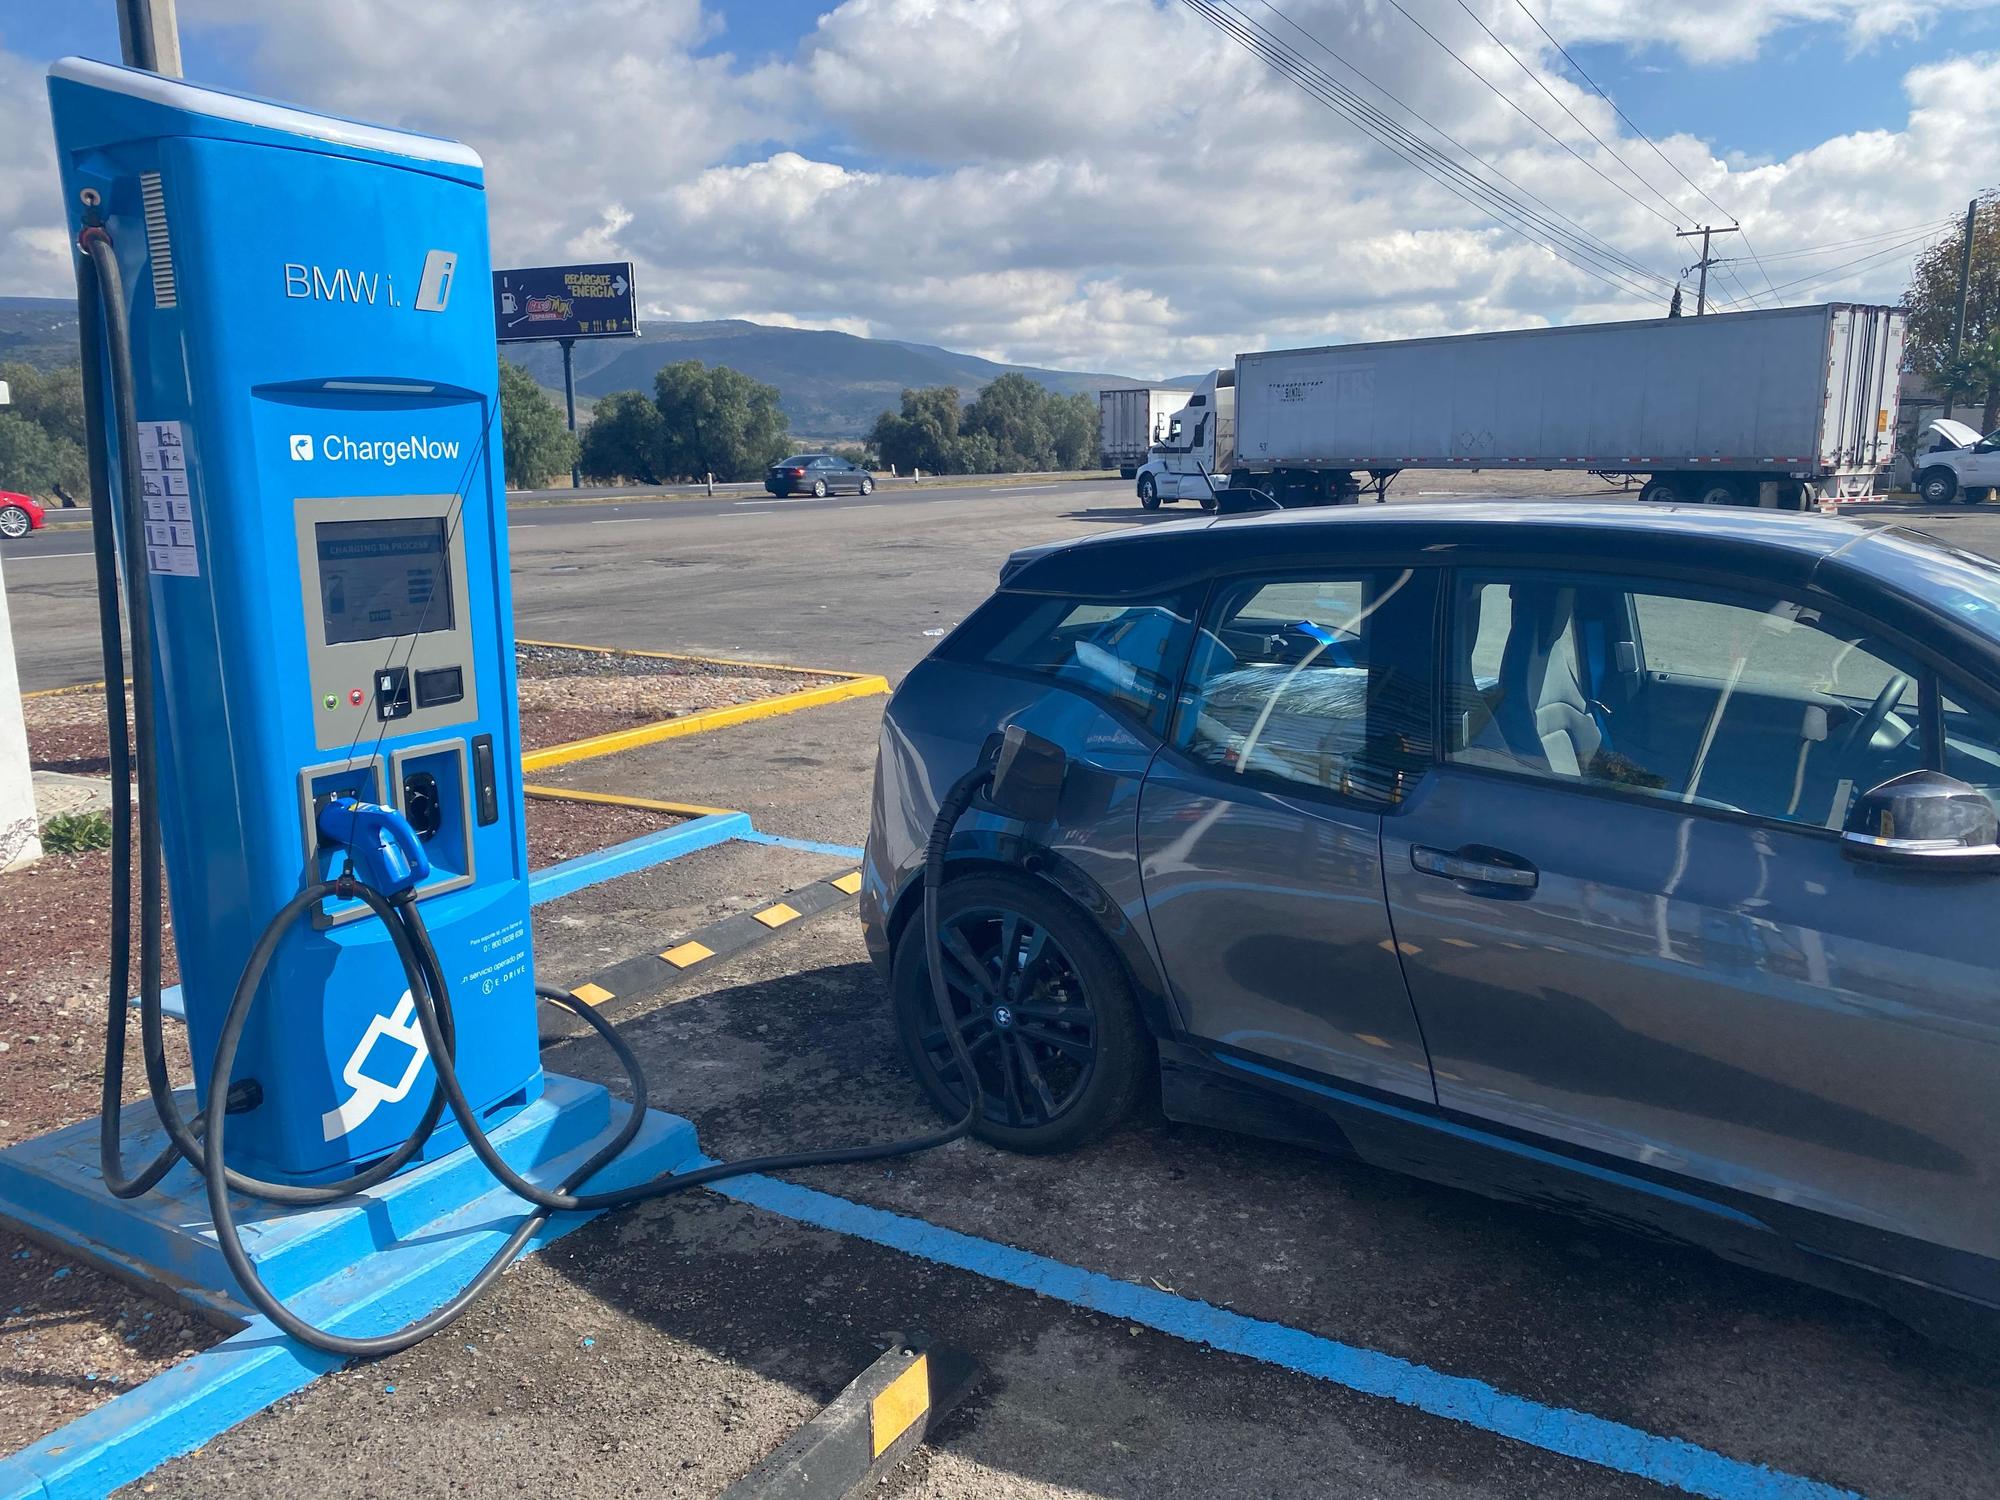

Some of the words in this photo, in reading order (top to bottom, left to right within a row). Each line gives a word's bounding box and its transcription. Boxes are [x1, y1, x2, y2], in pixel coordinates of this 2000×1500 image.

[284, 262, 379, 305] BMW
[323, 434, 460, 467] ChargeNow
[469, 966, 493, 981] servicio
[494, 955, 516, 971] operado
[503, 964, 526, 983] DRIVE
